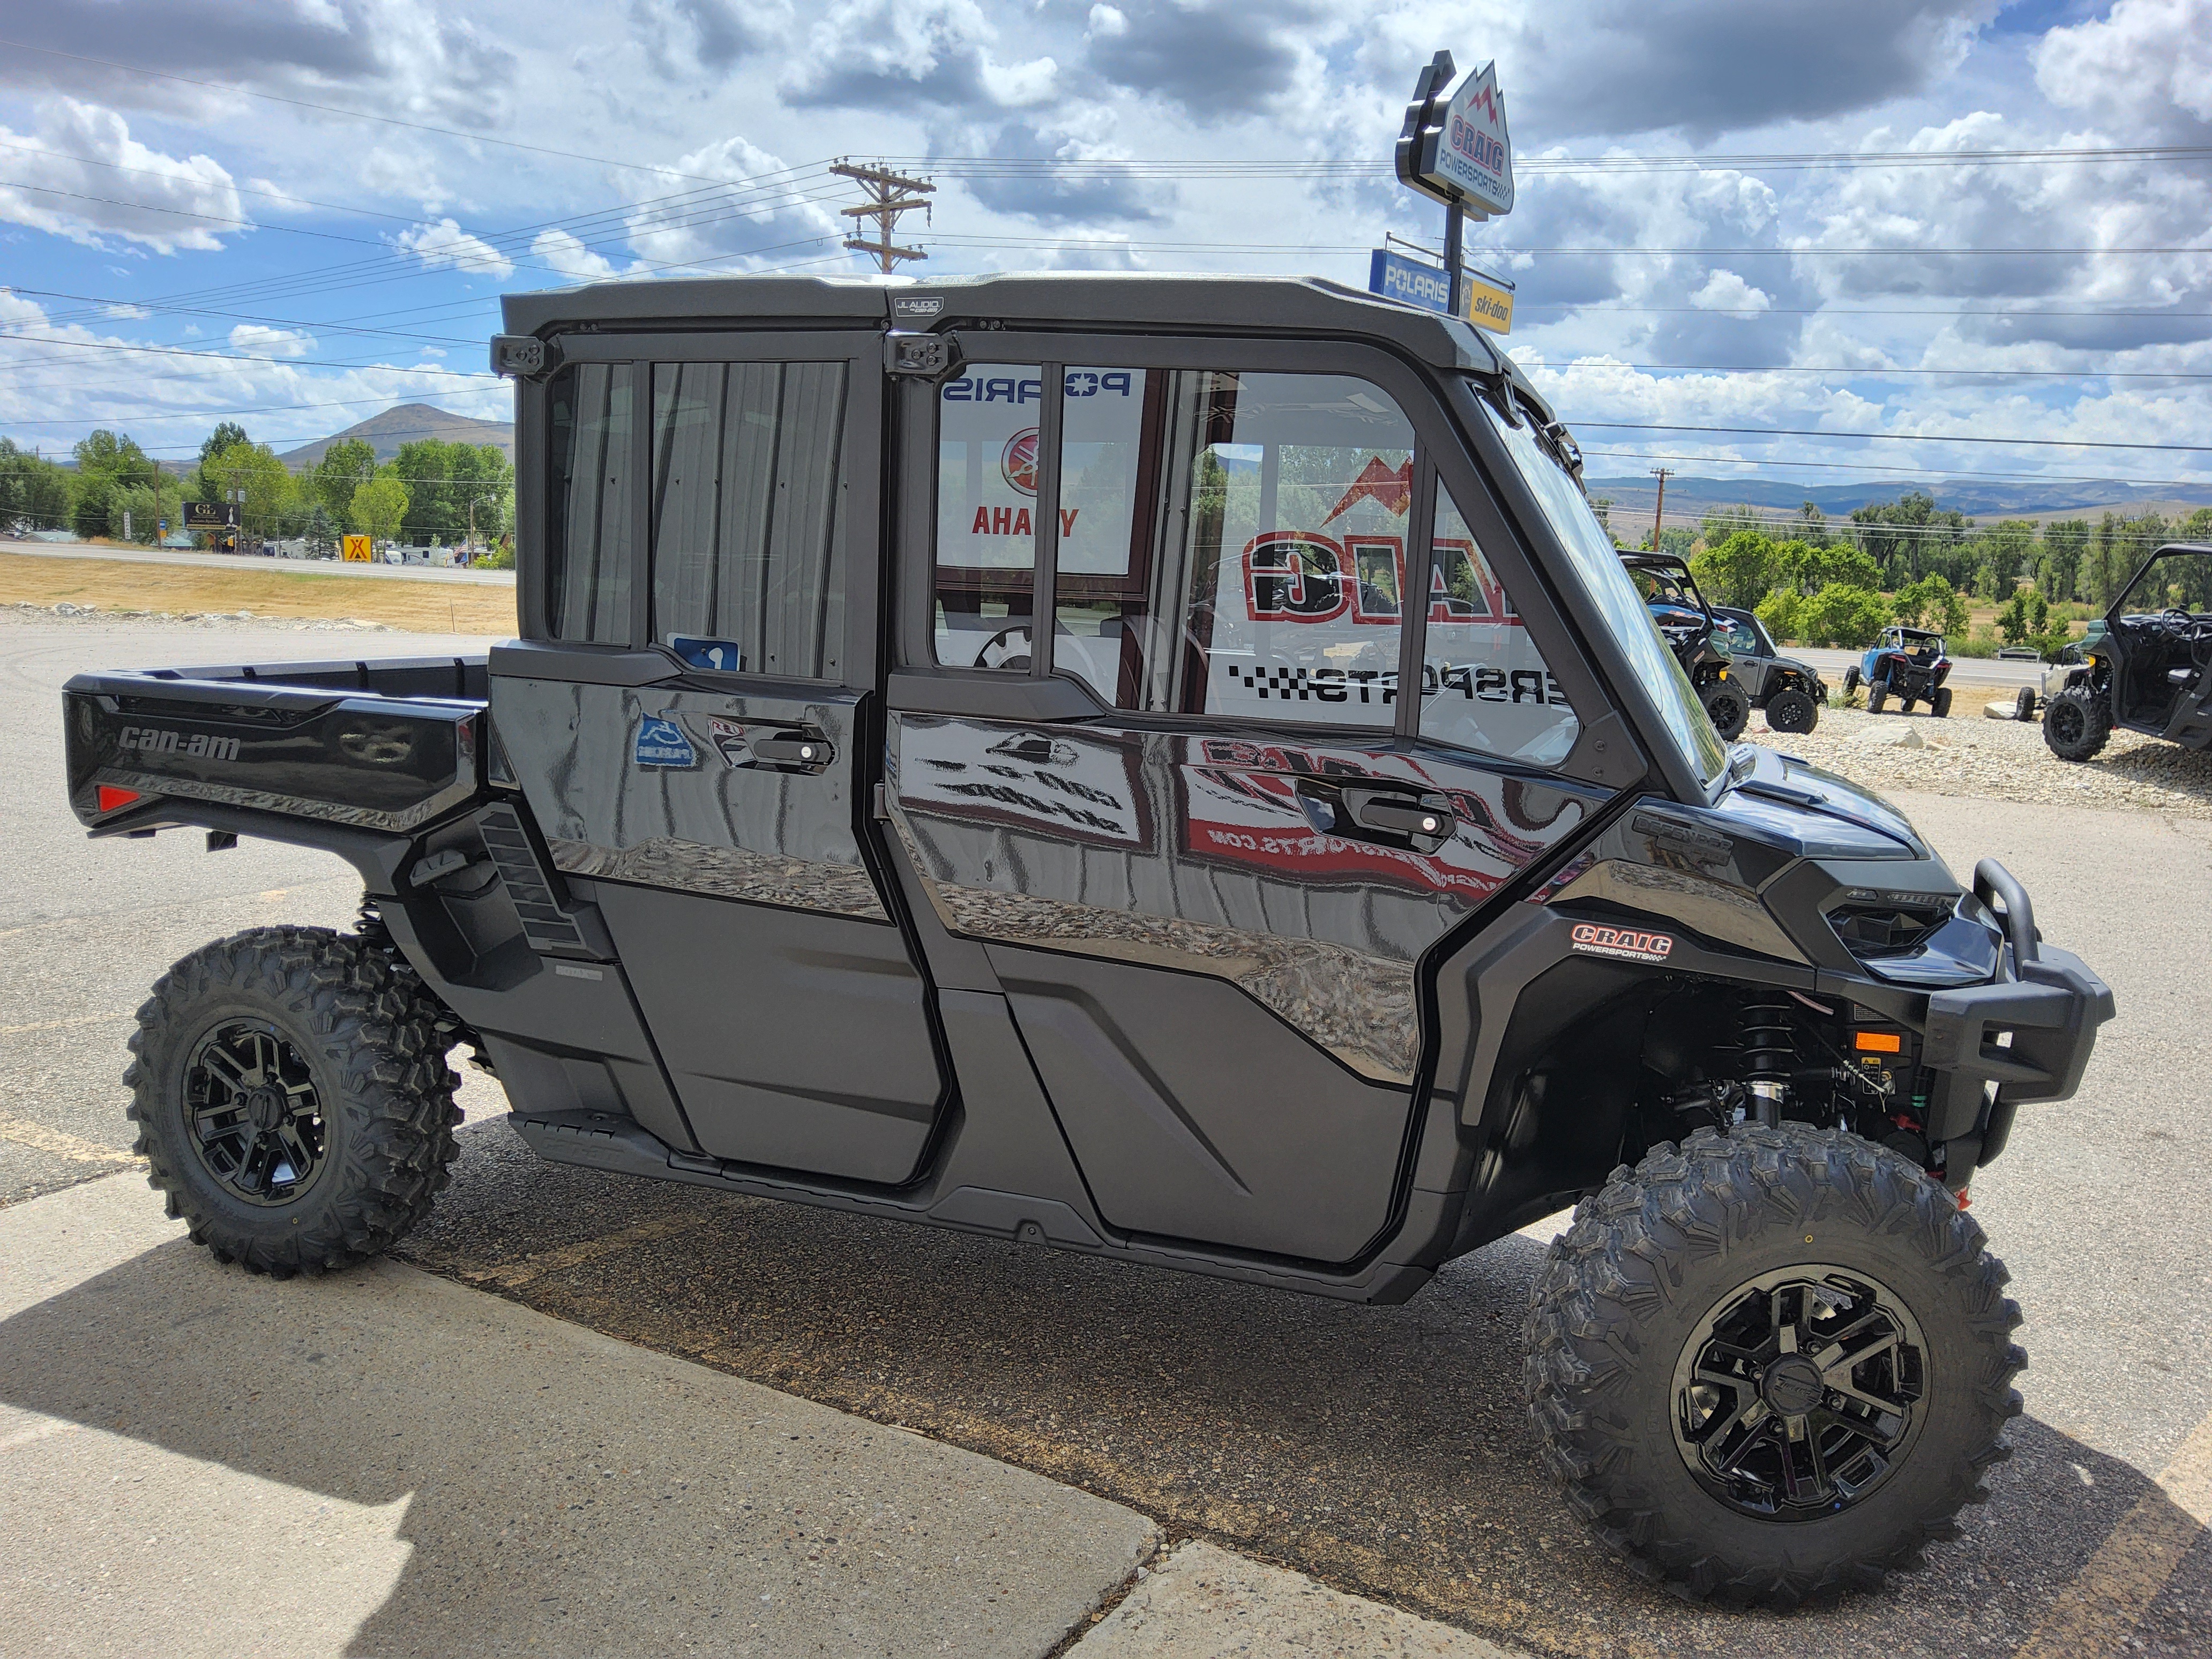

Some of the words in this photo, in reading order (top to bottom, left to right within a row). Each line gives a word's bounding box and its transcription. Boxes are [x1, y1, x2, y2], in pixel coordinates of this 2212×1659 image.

[1451, 114, 1504, 177] CRAIG
[1440, 148, 1498, 196] POWERSPORTS
[1385, 265, 1448, 304] POLARIS
[1475, 295, 1508, 322] ski-doo
[119, 726, 240, 761] can-am
[1634, 817, 1733, 851] DEFENDER
[1571, 924, 1673, 955] CRAIG
[1572, 942, 1649, 960] POWERSPORTS
